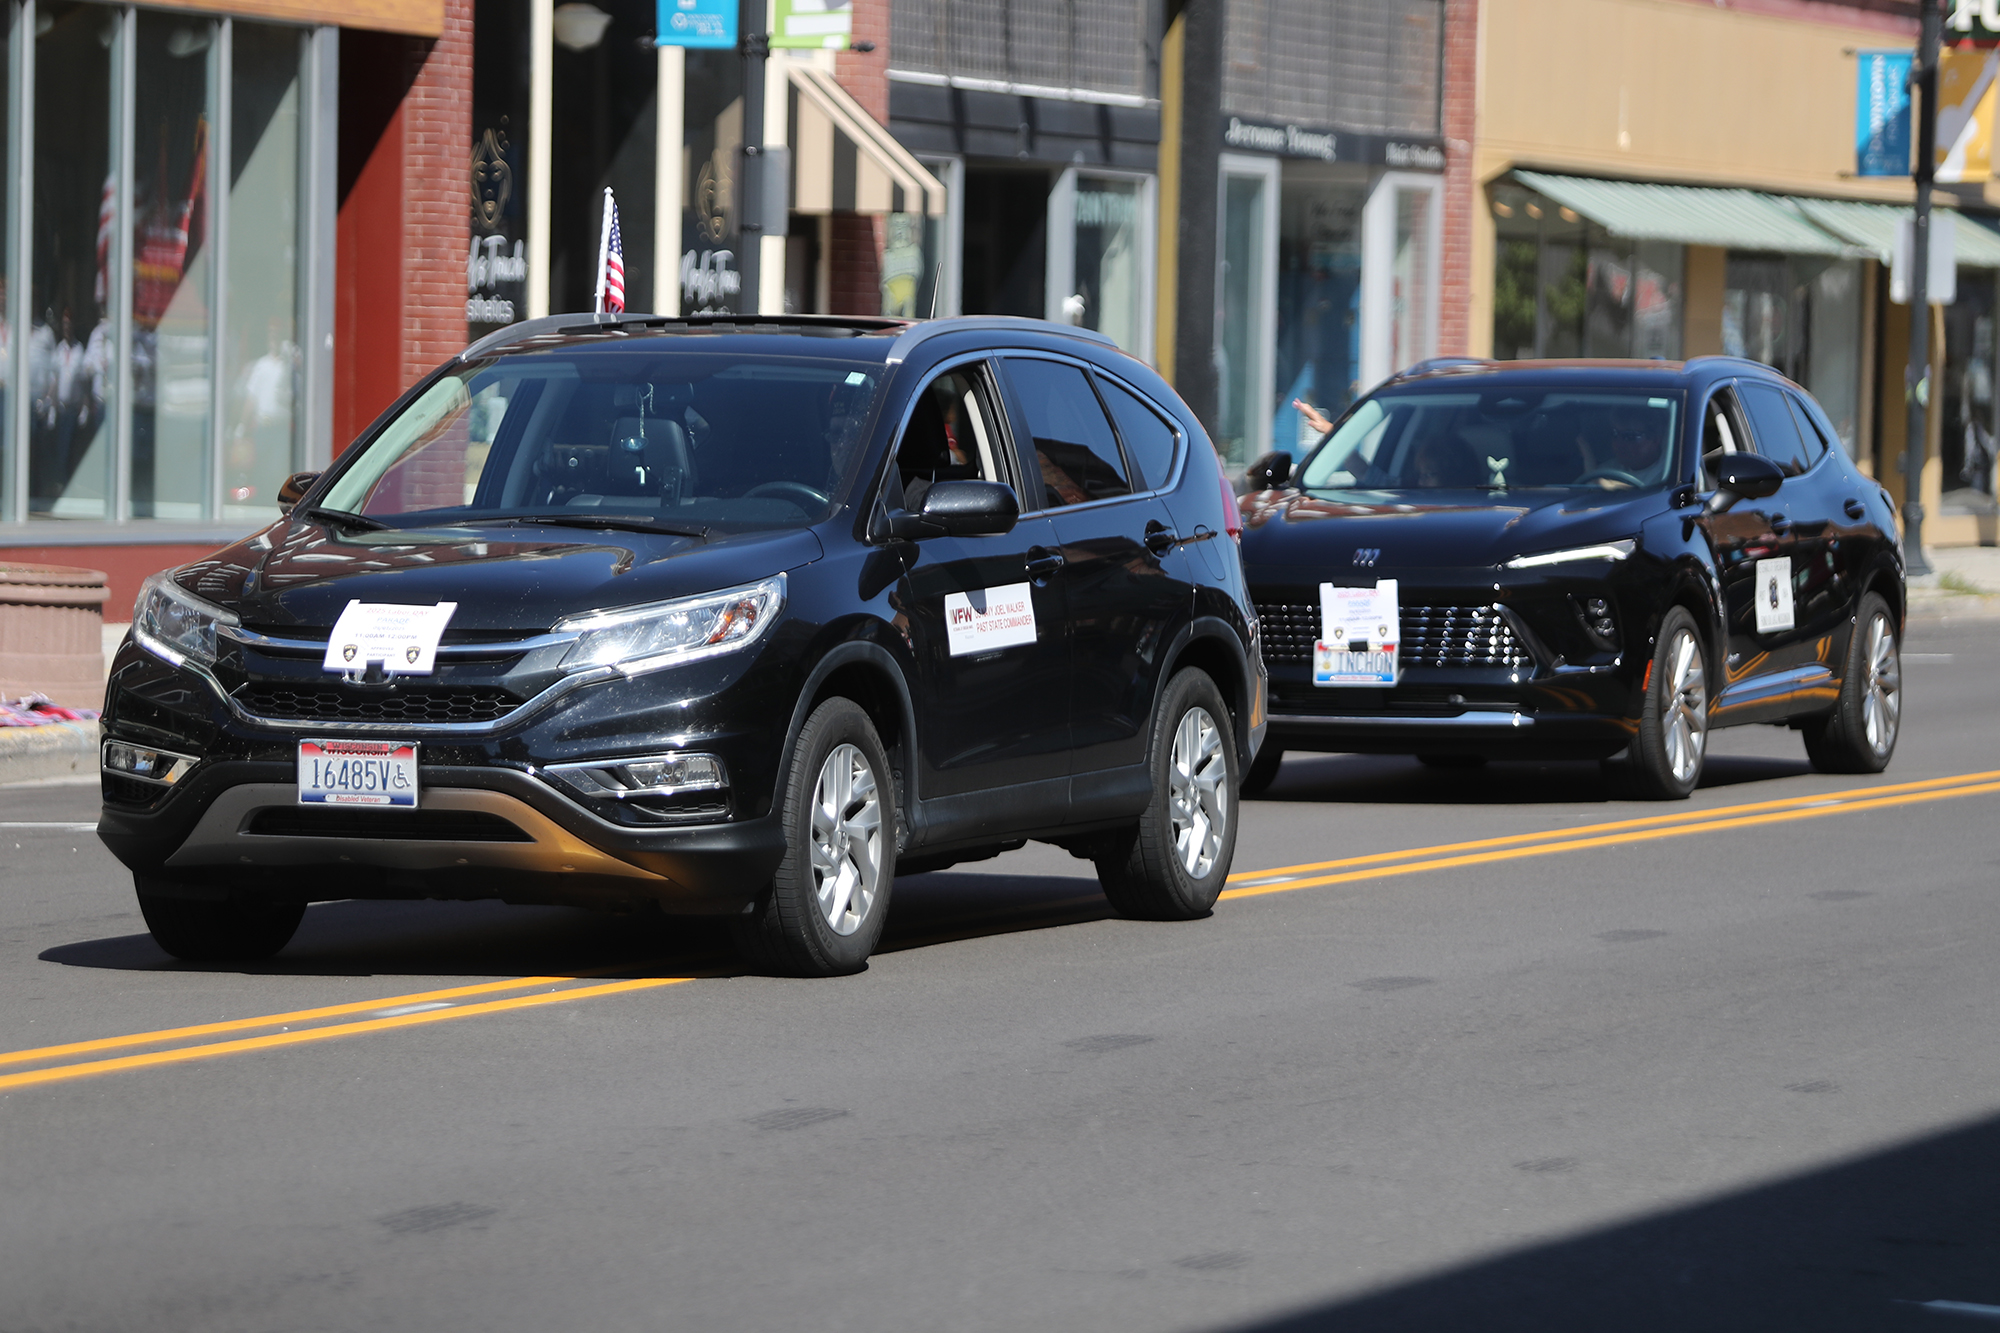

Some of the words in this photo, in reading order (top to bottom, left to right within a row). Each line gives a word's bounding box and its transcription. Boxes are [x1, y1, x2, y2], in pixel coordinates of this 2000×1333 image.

[951, 606, 972, 625] VFW
[994, 604, 1006, 617] JOEL
[1006, 601, 1026, 615] WALKER
[976, 621, 989, 634] PAST
[989, 618, 1004, 631] STATE
[1003, 614, 1033, 629] COMMANDER
[1338, 651, 1393, 673] INCHON
[333, 741, 383, 750] WISCONSIN
[312, 758, 390, 790] 16485V
[336, 794, 360, 802] Disabled
